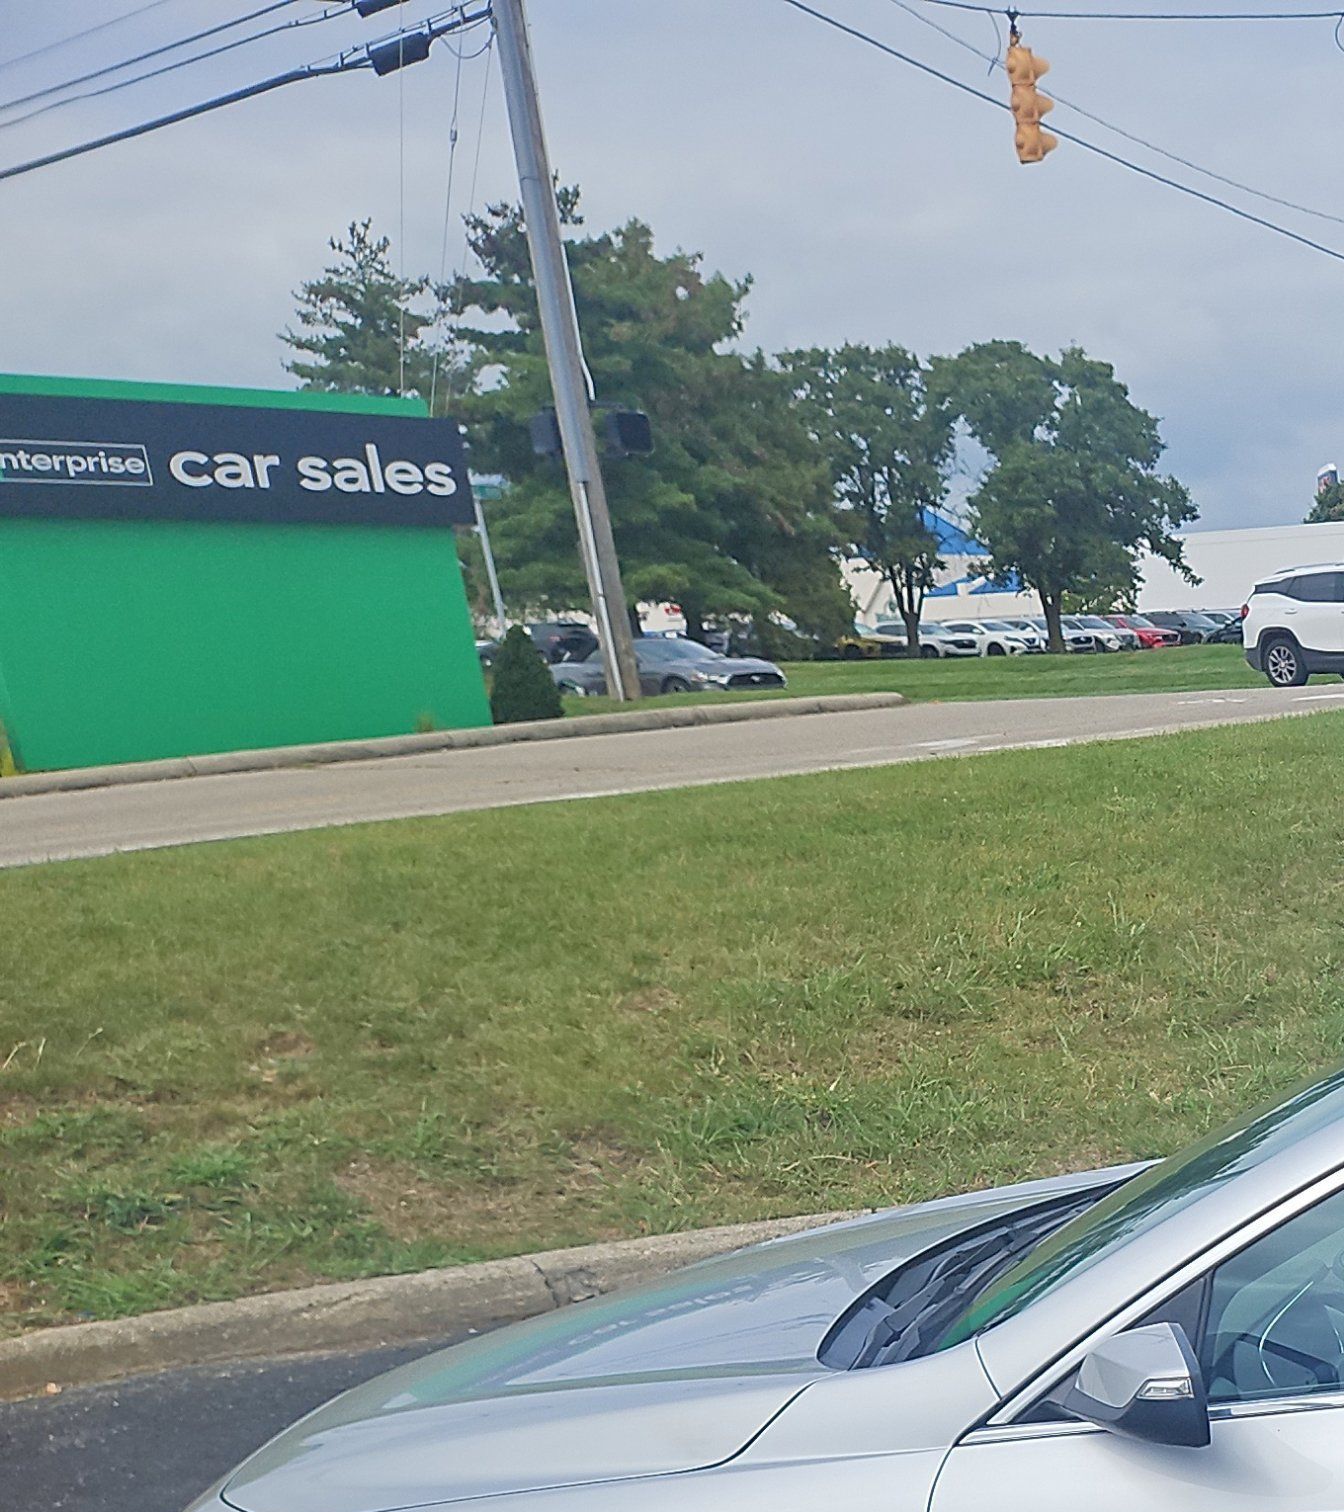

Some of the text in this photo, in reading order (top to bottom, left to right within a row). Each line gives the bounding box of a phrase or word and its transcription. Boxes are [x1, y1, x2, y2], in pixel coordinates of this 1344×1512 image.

[0, 442, 458, 497] nterprise car sales
